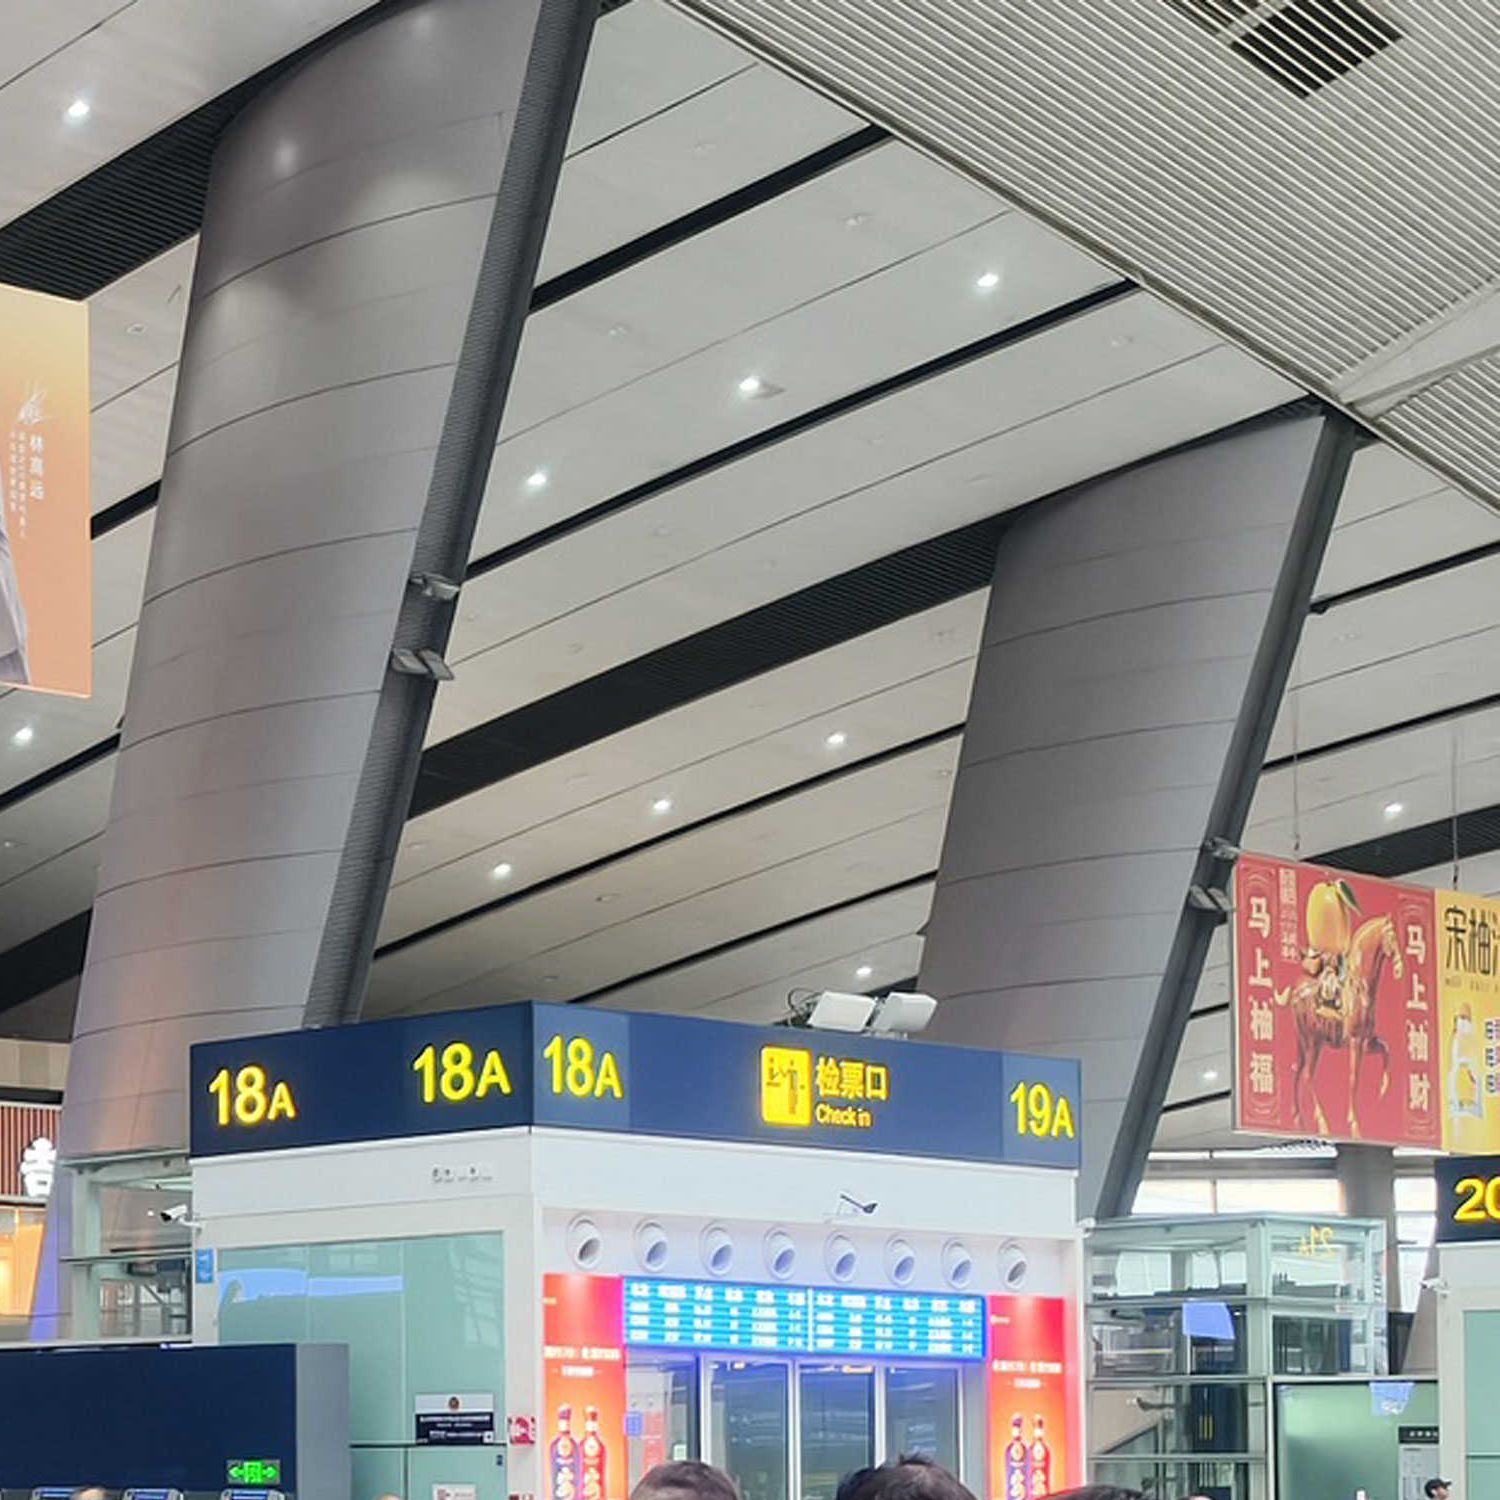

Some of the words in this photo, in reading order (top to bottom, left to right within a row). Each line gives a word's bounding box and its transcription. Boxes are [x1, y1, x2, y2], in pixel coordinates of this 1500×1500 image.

[208, 1064, 296, 1127] 18A
[412, 1040, 512, 1104] 18A
[543, 1034, 623, 1101] 18A
[815, 1056, 889, 1101] 检票口
[816, 1103, 856, 1127] Check
[857, 1107, 872, 1128] in
[1009, 1081, 1075, 1141] 19A
